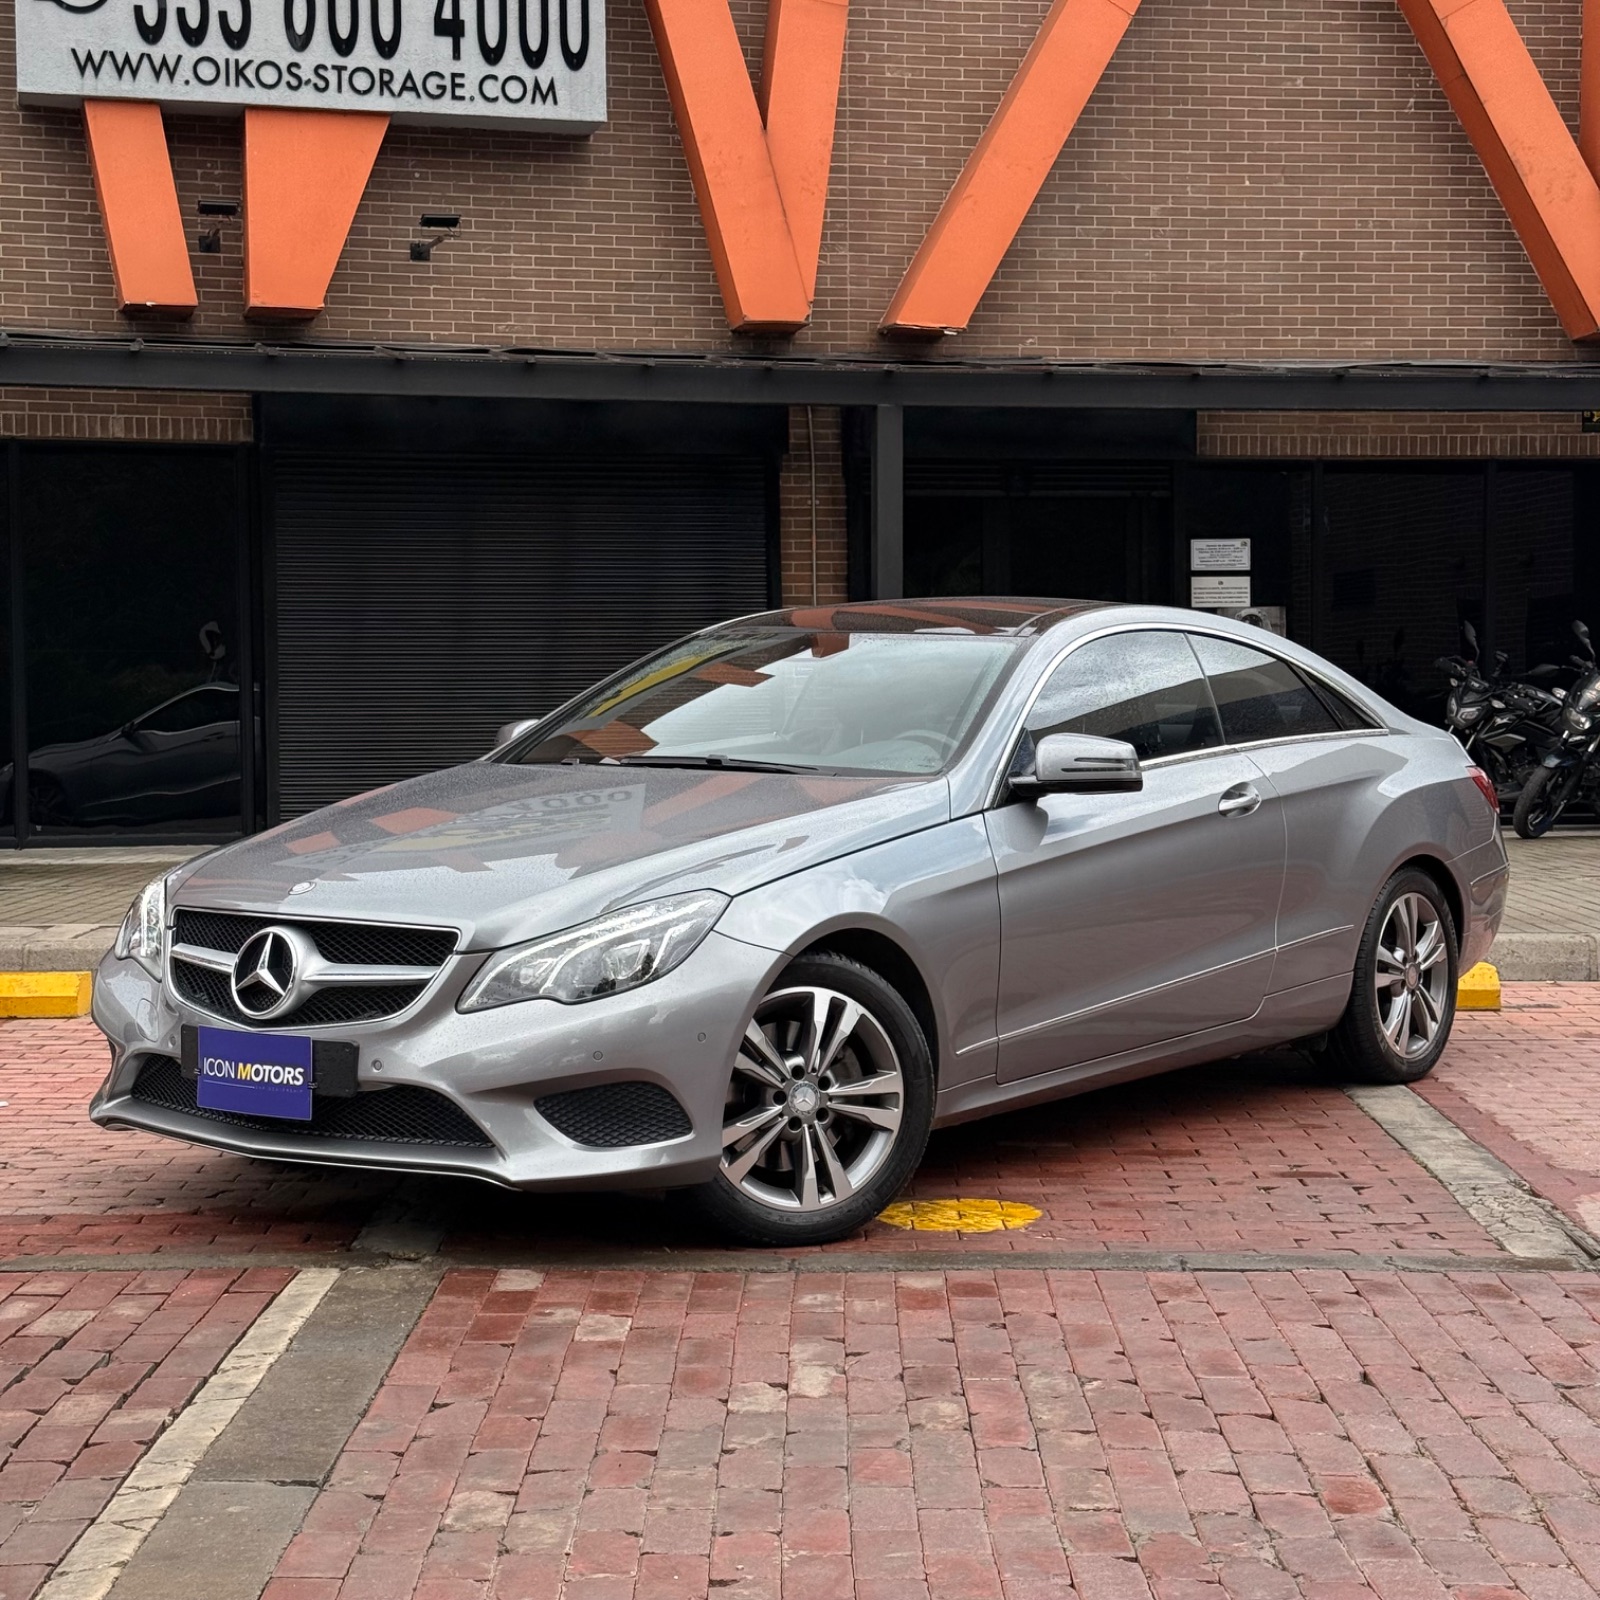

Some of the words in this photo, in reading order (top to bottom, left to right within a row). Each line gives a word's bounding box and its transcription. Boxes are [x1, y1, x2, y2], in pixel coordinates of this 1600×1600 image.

[71, 48, 558, 106] WWW.OIKOS-STORAGE.COM
[203, 1057, 235, 1079] ICON
[237, 1062, 305, 1086] MOTORS
